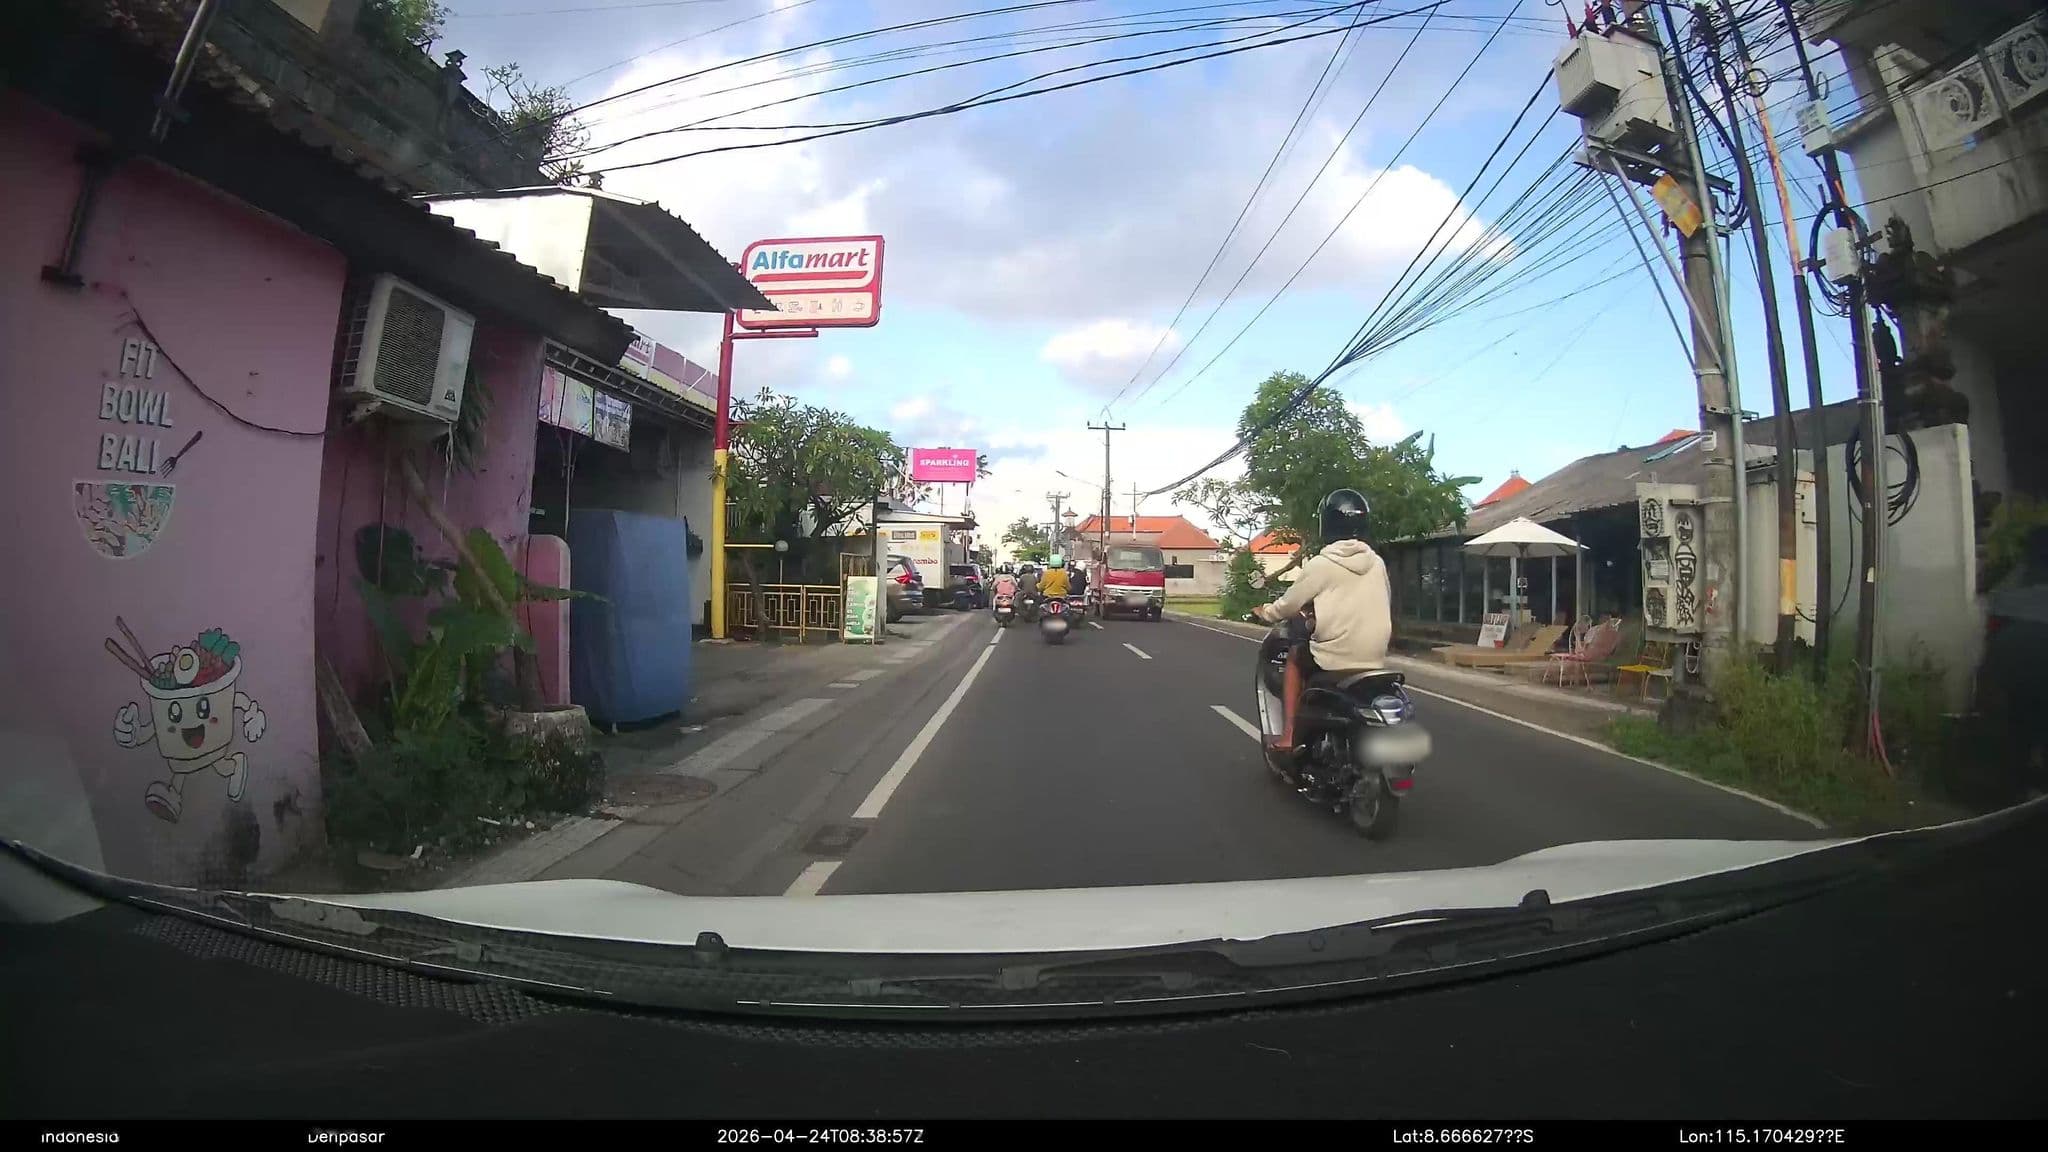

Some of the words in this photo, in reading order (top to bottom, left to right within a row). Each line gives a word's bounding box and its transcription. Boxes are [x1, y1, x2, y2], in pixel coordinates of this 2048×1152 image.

[752, 248, 869, 270] Alfamart
[120, 337, 159, 379] FIT
[99, 382, 173, 428] BOWL
[97, 432, 161, 475] BALI
